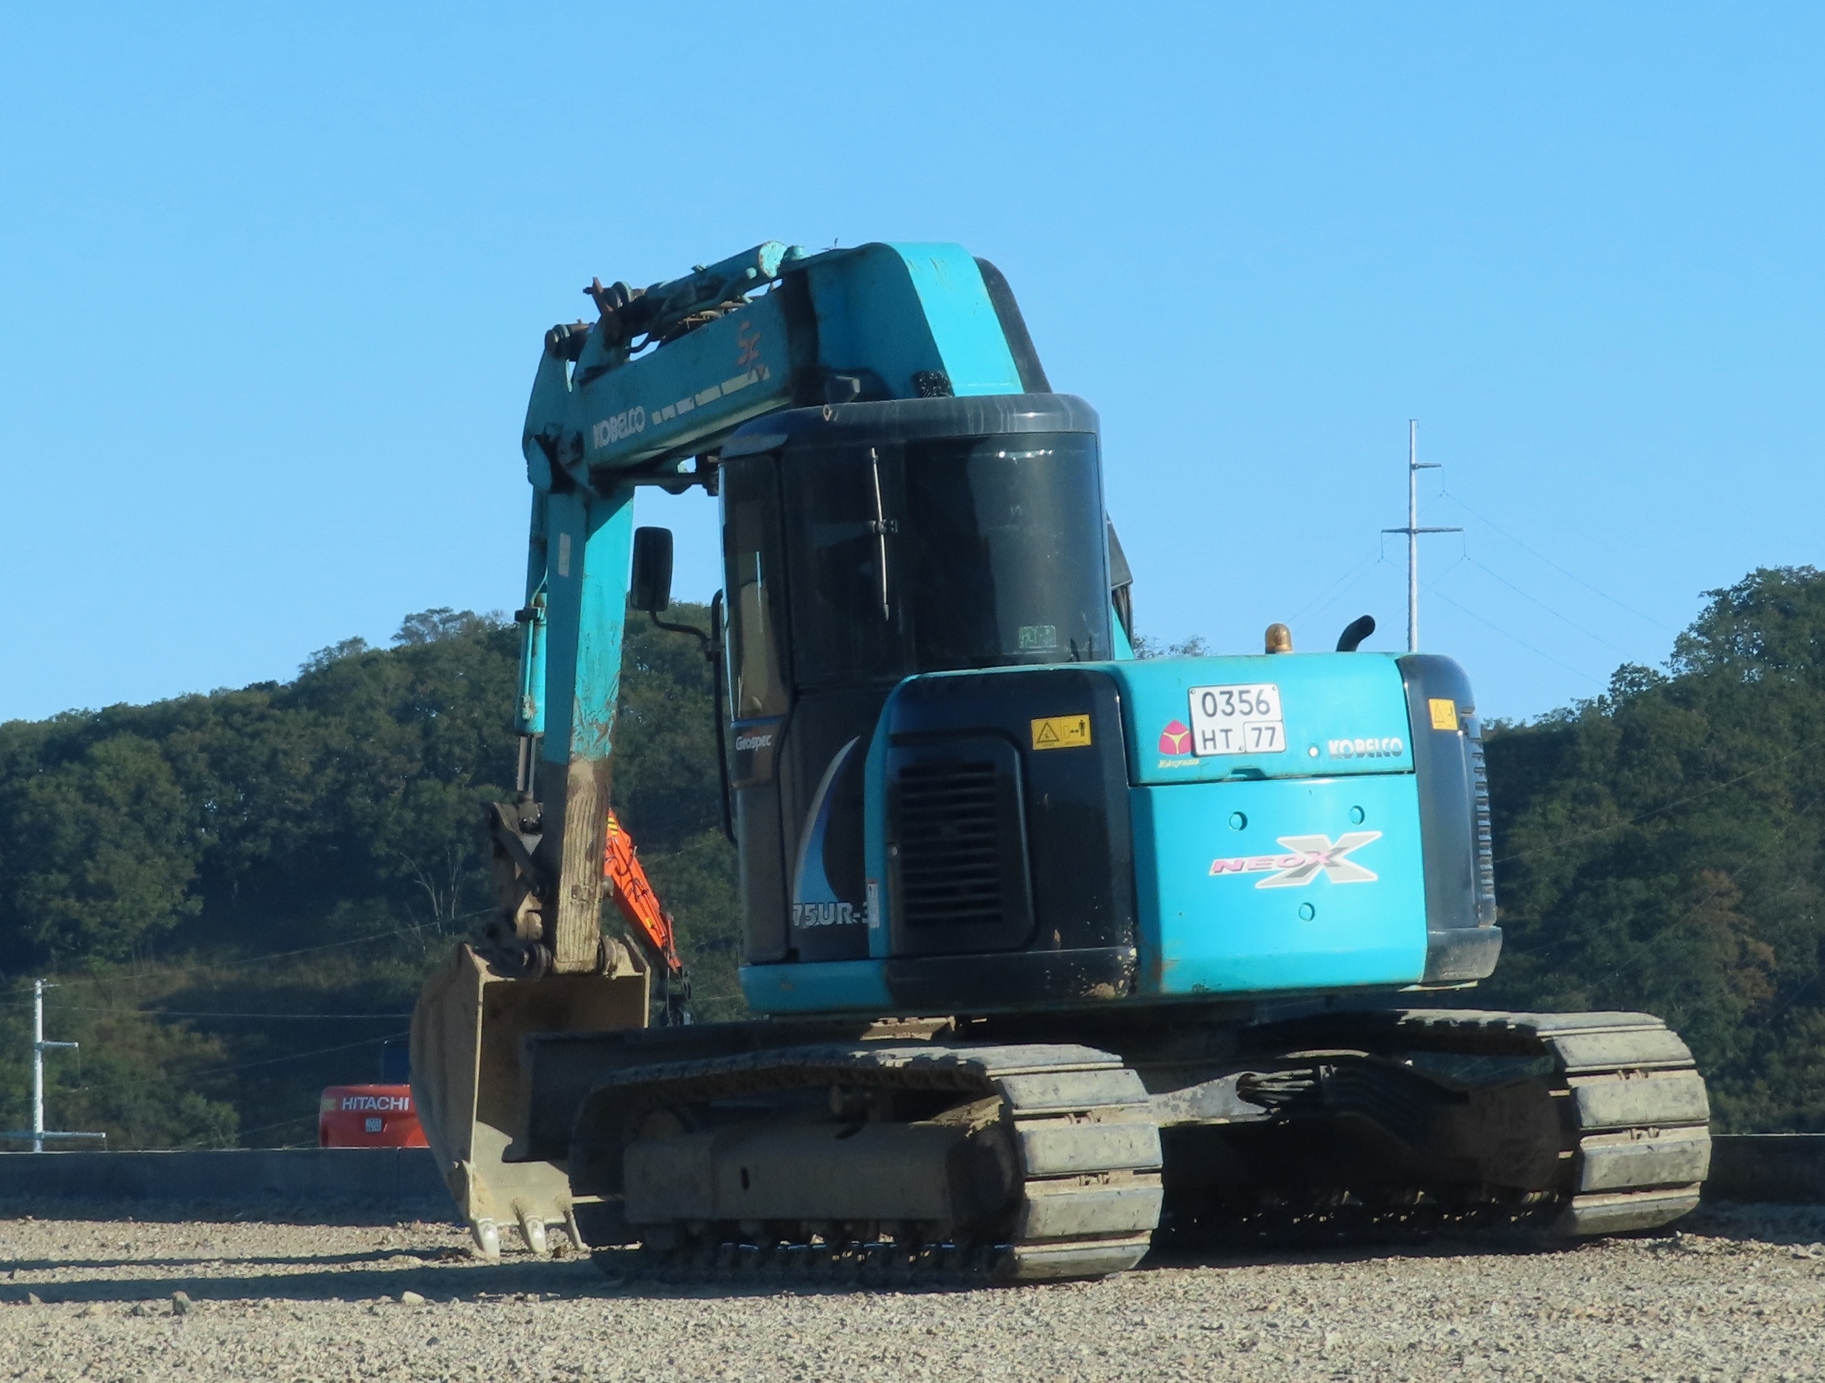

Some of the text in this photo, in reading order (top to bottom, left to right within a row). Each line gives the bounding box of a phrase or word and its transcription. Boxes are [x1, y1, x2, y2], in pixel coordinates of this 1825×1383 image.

[593, 406, 645, 449] KOBELCO
[1201, 689, 1271, 717] 0356
[1202, 726, 1277, 751] HT 77
[1328, 737, 1403, 759] KOBELCO
[341, 1096, 410, 1111] HITACHI
